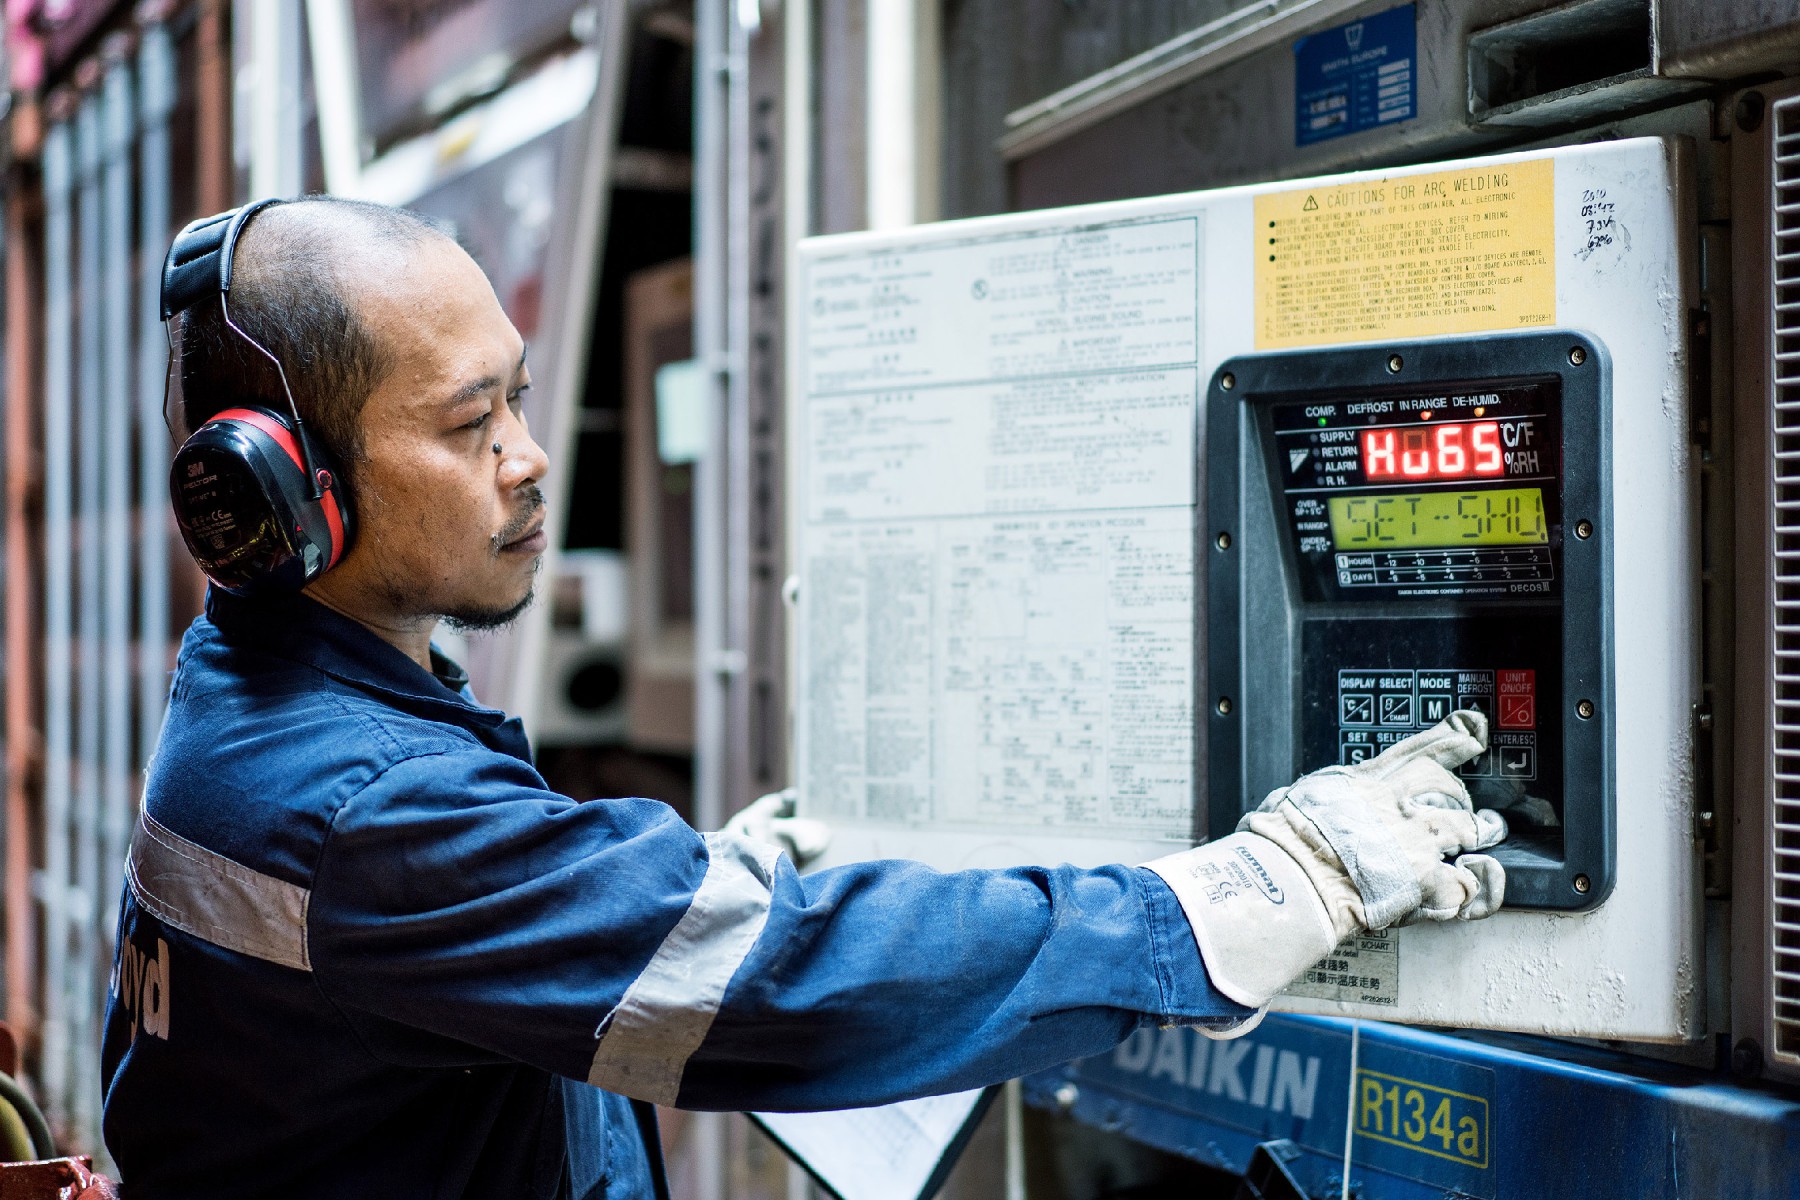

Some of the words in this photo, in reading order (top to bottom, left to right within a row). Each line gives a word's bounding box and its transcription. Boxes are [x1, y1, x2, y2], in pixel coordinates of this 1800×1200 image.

[1327, 188, 1384, 208] CAUTIONS
[1394, 184, 1415, 200] FOR
[1423, 180, 1445, 196] ARC
[1453, 173, 1508, 193] WELDING
[1355, 210, 1365, 218] ANY
[1370, 207, 1384, 216] PART
[1388, 206, 1395, 214] OF
[1400, 204, 1414, 212] THIS
[1460, 197, 1471, 205] ALL
[1476, 192, 1515, 203] ELECTRONIC
[1373, 222, 1410, 233] ELECTRONIC
[1449, 215, 1468, 224] REFER
[1472, 214, 1480, 222] TO
[1388, 232, 1395, 240] OF
[1396, 237, 1434, 248] PREVENTING
[1438, 234, 1460, 243] STATIC
[1344, 254, 1359, 262] WITH
[1363, 252, 1373, 260] THE
[1378, 250, 1396, 259] EARTH
[1306, 405, 1336, 418] COMP.
[1347, 401, 1394, 414] DEFROST
[1400, 400, 1410, 410] IN
[1412, 397, 1447, 410] RANGE
[1453, 394, 1501, 407] DE-HUMID.
[1320, 431, 1355, 443] SUPPLY
[1322, 446, 1358, 457] RETURN
[187, 462, 204, 477] 3M
[1325, 461, 1357, 472] ALARM
[1504, 451, 1540, 474] %RH
[184, 474, 218, 489] PELTOR
[1297, 500, 1318, 508] OVER
[1300, 537, 1326, 545] UNDER
[1349, 557, 1372, 565] HOURS
[1384, 559, 1396, 567] -12
[1469, 556, 1480, 564] -6
[1498, 555, 1509, 563] -4
[1352, 573, 1373, 581] DAYS
[1531, 570, 1540, 578] -1
[1341, 678, 1375, 689] DISPLAY
[1380, 678, 1412, 689] SELECT
[1420, 678, 1451, 688] MODE
[1459, 674, 1491, 683] MANUAL
[1506, 673, 1526, 682] UNIT
[1458, 684, 1492, 694] DEFROST
[1501, 683, 1532, 693] ON/OFF
[1428, 700, 1441, 719] M
[1348, 732, 1368, 742] SET
[1494, 735, 1534, 745] ENTER/ESC
[1236, 846, 1278, 893] format
[1342, 950, 1358, 958] detail
[1113, 1027, 1321, 1120] DAIKIN
[1361, 1077, 1480, 1158] R134a
